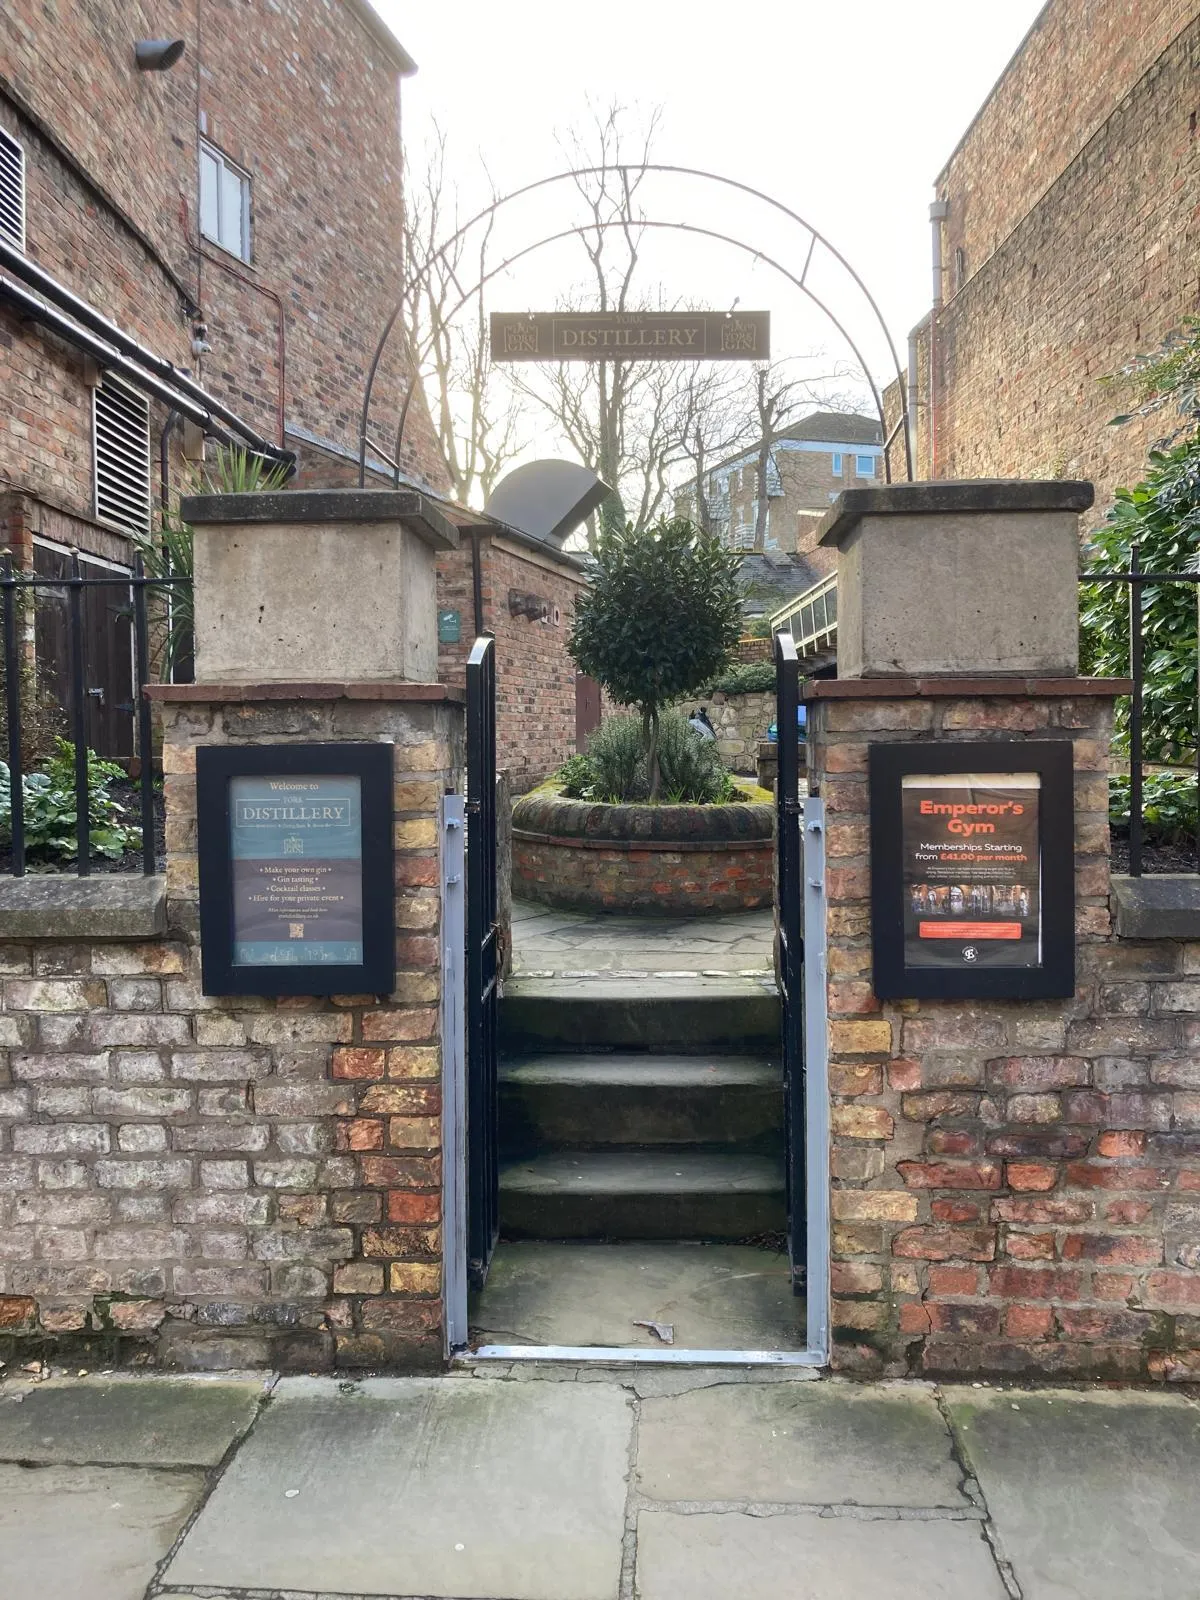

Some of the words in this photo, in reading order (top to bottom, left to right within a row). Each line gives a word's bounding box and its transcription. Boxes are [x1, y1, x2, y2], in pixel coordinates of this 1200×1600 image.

[561, 328, 698, 346] DISTILLERY
[269, 782, 308, 790] Welcome
[243, 807, 344, 820] DISTILLERY
[920, 800, 1024, 817] Emperor's
[948, 818, 995, 837] Gym
[920, 843, 982, 852] Memberships
[984, 843, 1023, 853] Starting
[915, 852, 938, 861] from
[940, 853, 975, 861] £41.00
[315, 867, 327, 875] gin
[297, 895, 319, 903] private
